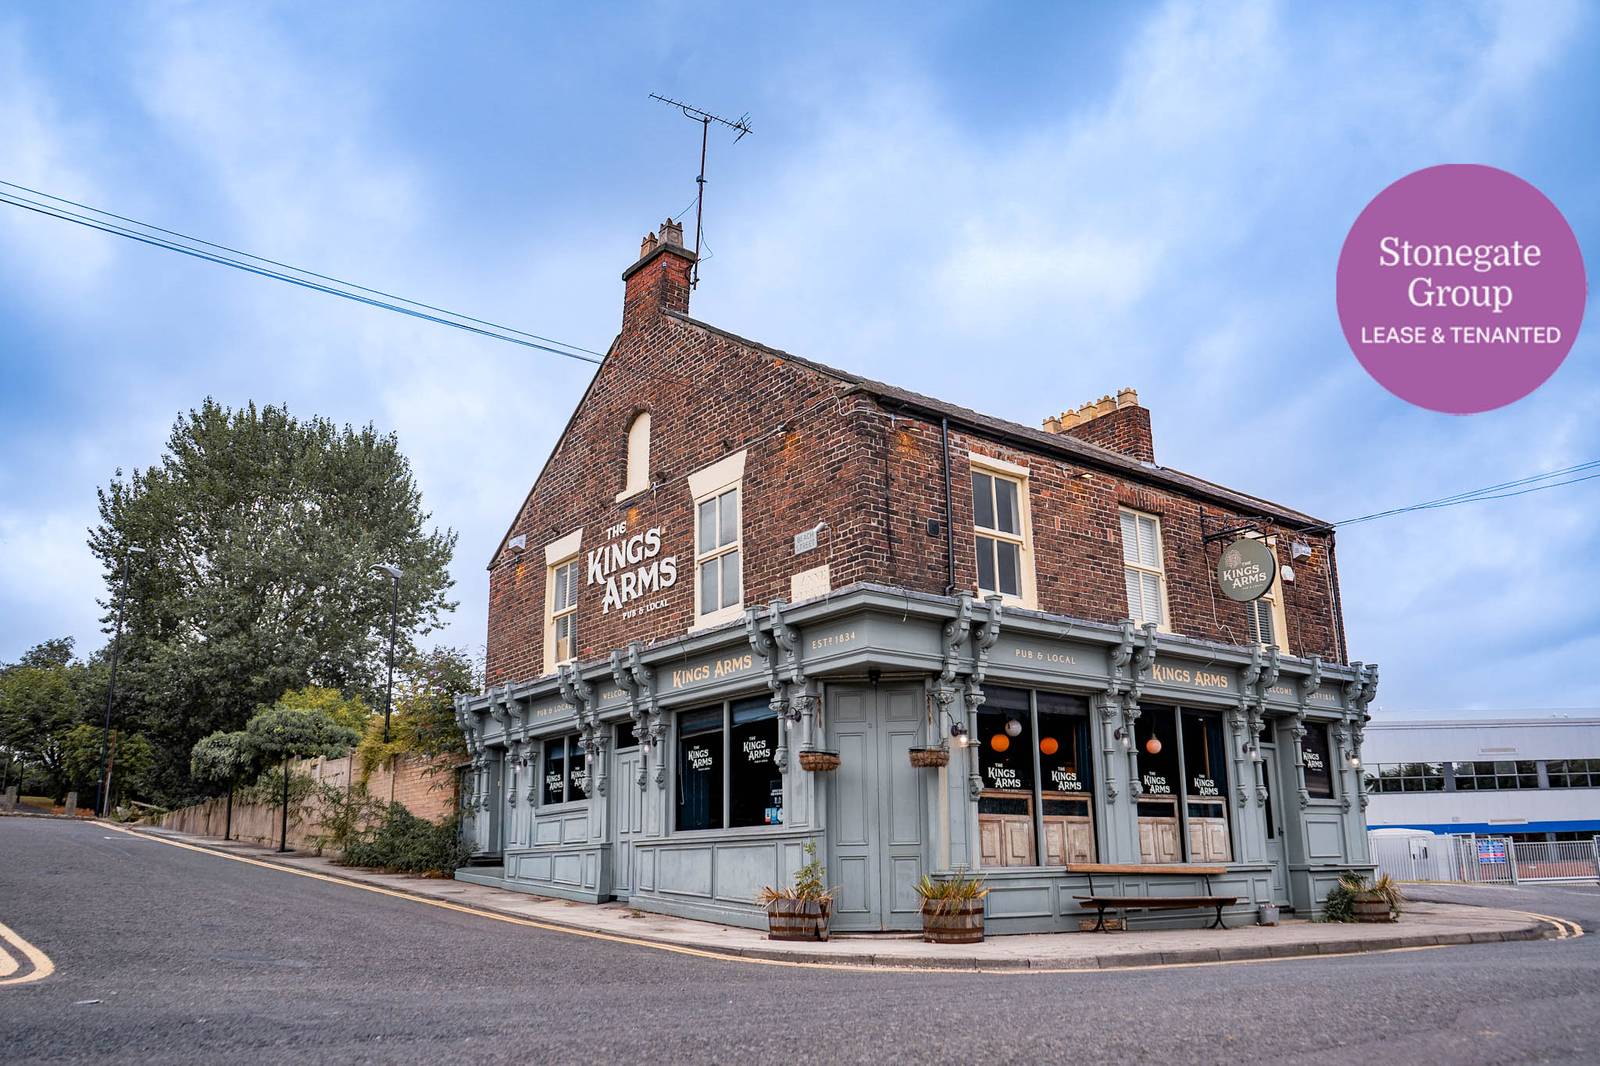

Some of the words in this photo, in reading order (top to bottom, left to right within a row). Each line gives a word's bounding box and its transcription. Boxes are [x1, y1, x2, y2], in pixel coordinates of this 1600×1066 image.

[606, 520, 627, 540] THE
[587, 526, 661, 585] KINGS
[1223, 564, 1260, 581] KINGS
[601, 555, 677, 614] ARMS
[1232, 572, 1267, 589] ARMS
[623, 609, 637, 620] PUB
[646, 599, 670, 613] LOCAL
[834, 631, 855, 646] 1834
[1015, 648, 1033, 659] PUB
[1037, 651, 1043, 661] &
[1047, 653, 1076, 665] LOCAL
[673, 665, 710, 688] KINGS
[714, 654, 753, 680] ARMS
[1152, 664, 1190, 683] KINGS
[1194, 671, 1228, 689] ARMS
[743, 740, 766, 753] KINGS
[688, 749, 709, 762] KINGS
[748, 748, 771, 761] ARMS
[692, 757, 713, 769] ARMS
[988, 767, 1016, 779] KINGS
[1051, 771, 1077, 782] KINGS
[995, 778, 1021, 789] ARMS
[1058, 781, 1082, 791] ARMS
[1143, 775, 1166, 786] KINGS
[1194, 778, 1214, 788] KINGS
[1149, 785, 1171, 794] ARMS
[1200, 787, 1219, 796] ARMS
